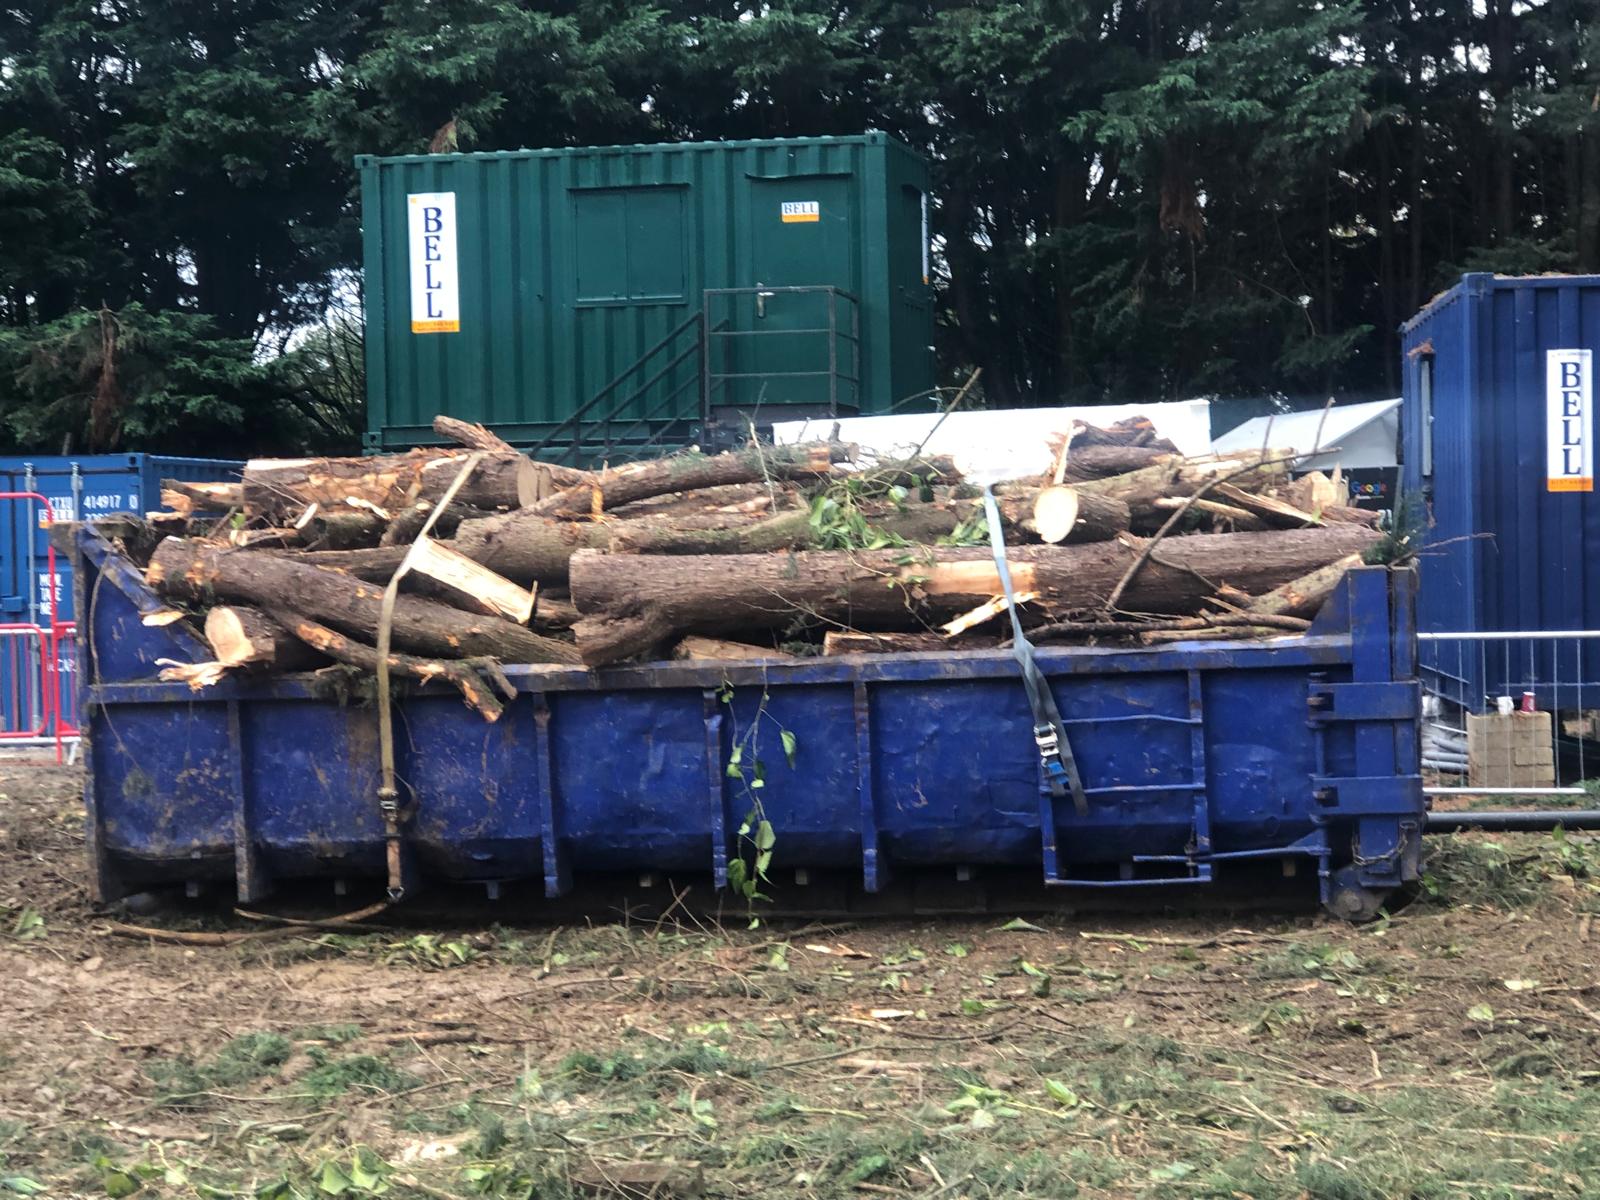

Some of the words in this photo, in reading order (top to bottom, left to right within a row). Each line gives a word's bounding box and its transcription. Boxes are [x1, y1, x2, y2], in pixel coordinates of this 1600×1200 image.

[422, 206, 443, 319] BELL
[783, 202, 818, 215] BELL
[1560, 361, 1582, 476] BELL
